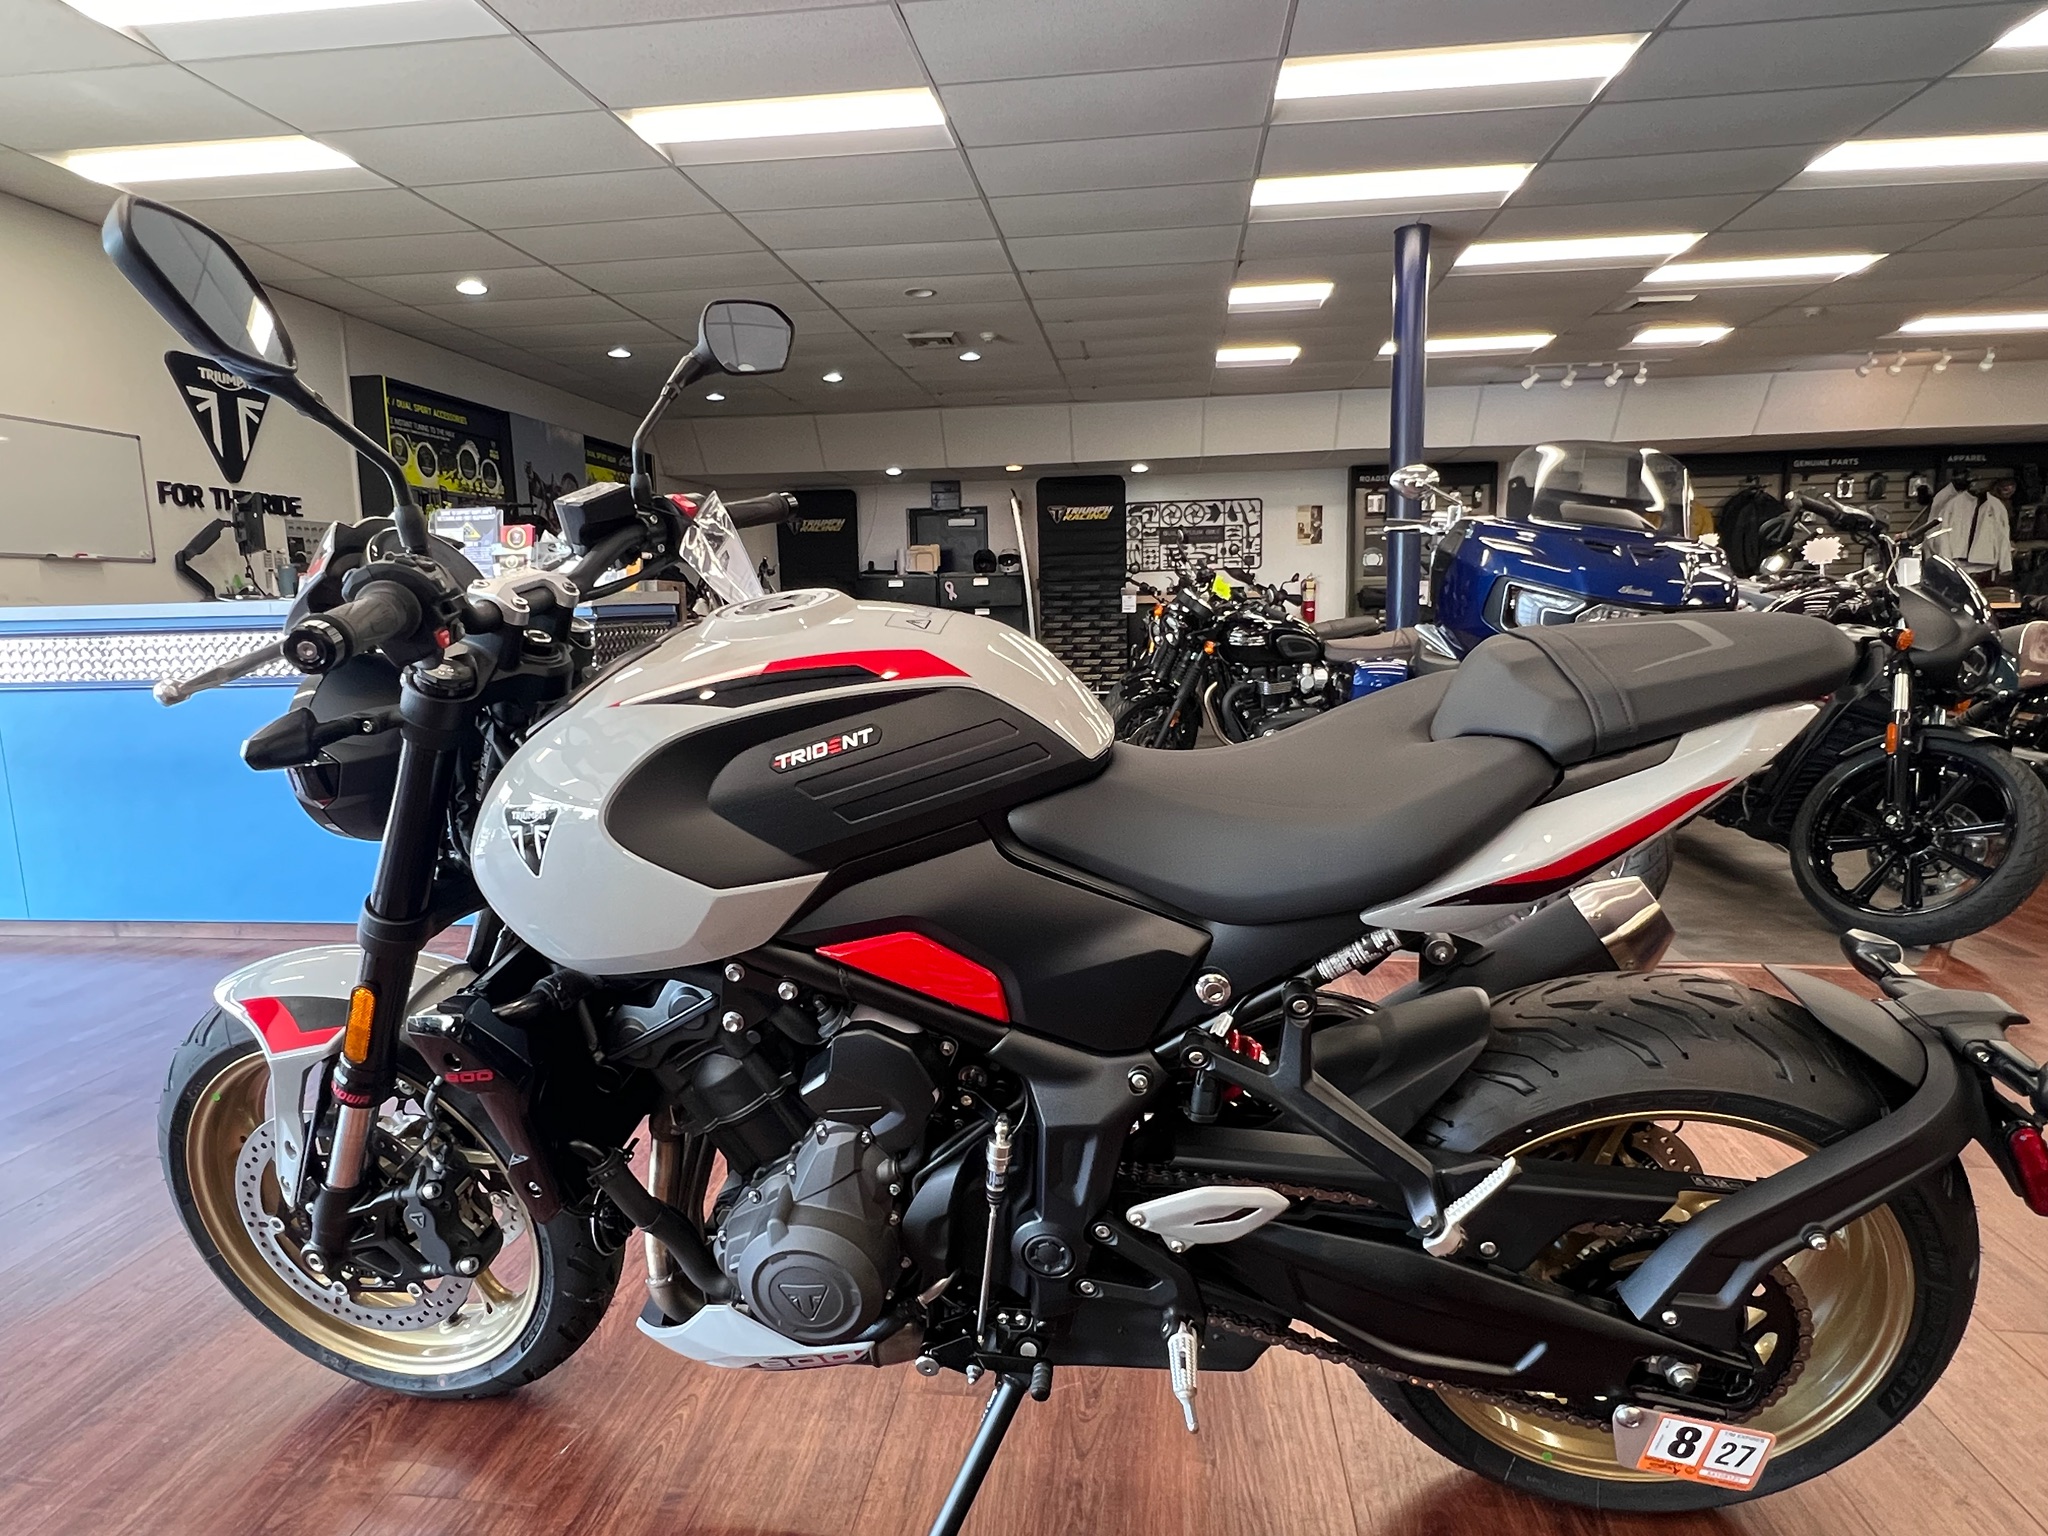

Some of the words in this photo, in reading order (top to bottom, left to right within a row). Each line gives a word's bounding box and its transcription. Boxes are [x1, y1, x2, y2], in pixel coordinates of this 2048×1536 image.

[197, 366, 252, 390] TRIUMP
[1793, 459, 1830, 467] GENUINE
[1946, 454, 1987, 462] APPAREL
[157, 481, 205, 509] FOR
[259, 493, 304, 518] RIDE
[1065, 505, 1114, 515] TRIUMPH
[773, 727, 874, 769] TRIDENT
[511, 810, 547, 821] TRIUMPH
[1667, 1426, 1703, 1459] 8
[1714, 1441, 1757, 1468] 27
